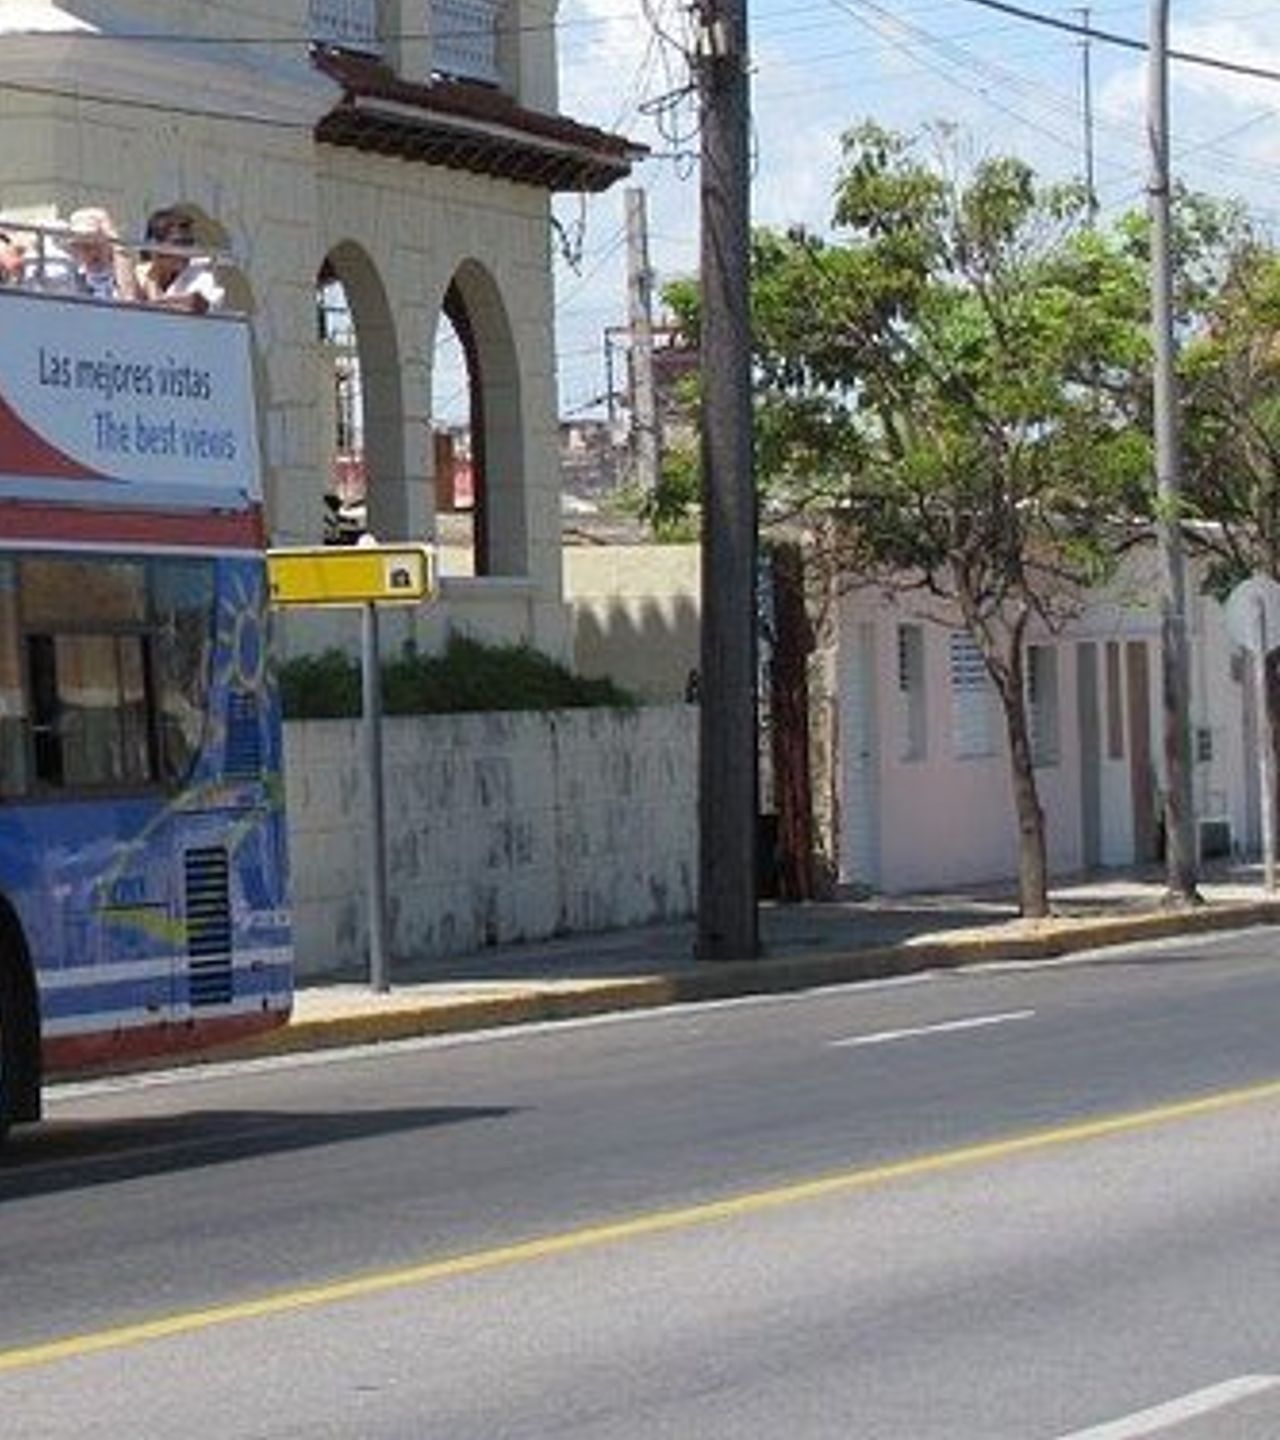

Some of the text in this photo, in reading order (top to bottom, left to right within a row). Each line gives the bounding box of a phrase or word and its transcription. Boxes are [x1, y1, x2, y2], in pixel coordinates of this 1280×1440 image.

[39, 347, 210, 400] Las mejores vistas
[95, 412, 237, 460] The best views
